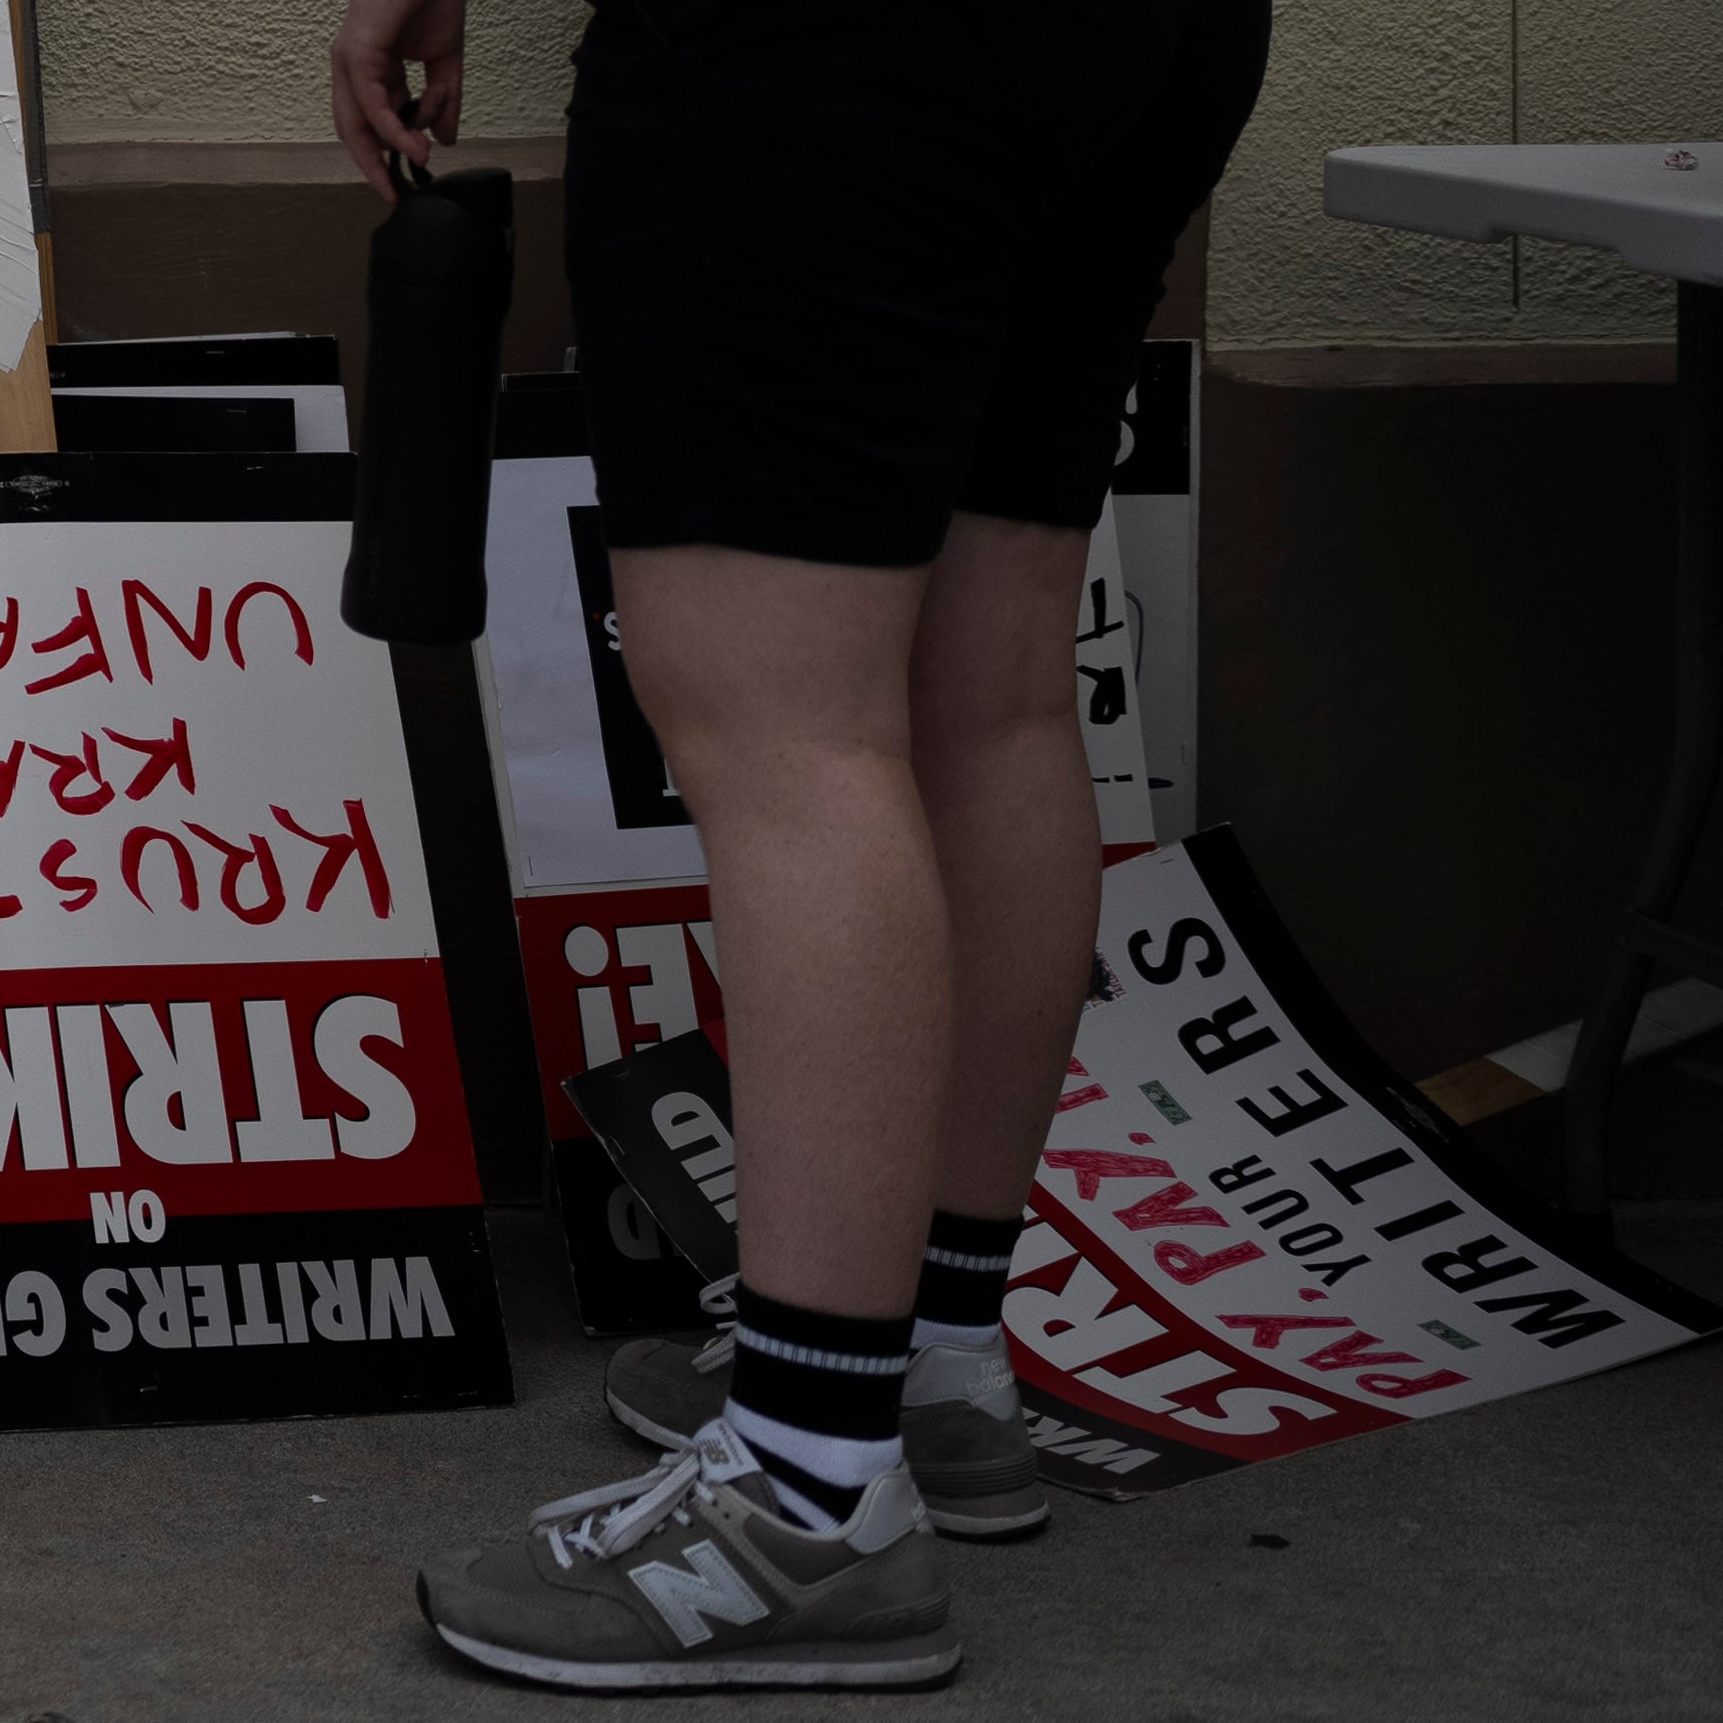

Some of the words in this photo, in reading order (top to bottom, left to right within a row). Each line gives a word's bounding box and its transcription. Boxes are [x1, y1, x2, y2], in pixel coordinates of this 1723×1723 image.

[1127, 917, 1627, 1350] WRITERS
[90, 1188, 166, 1246] ON
[1207, 1153, 1372, 1287] YOUR
[84, 1255, 458, 1353] WRITERS
